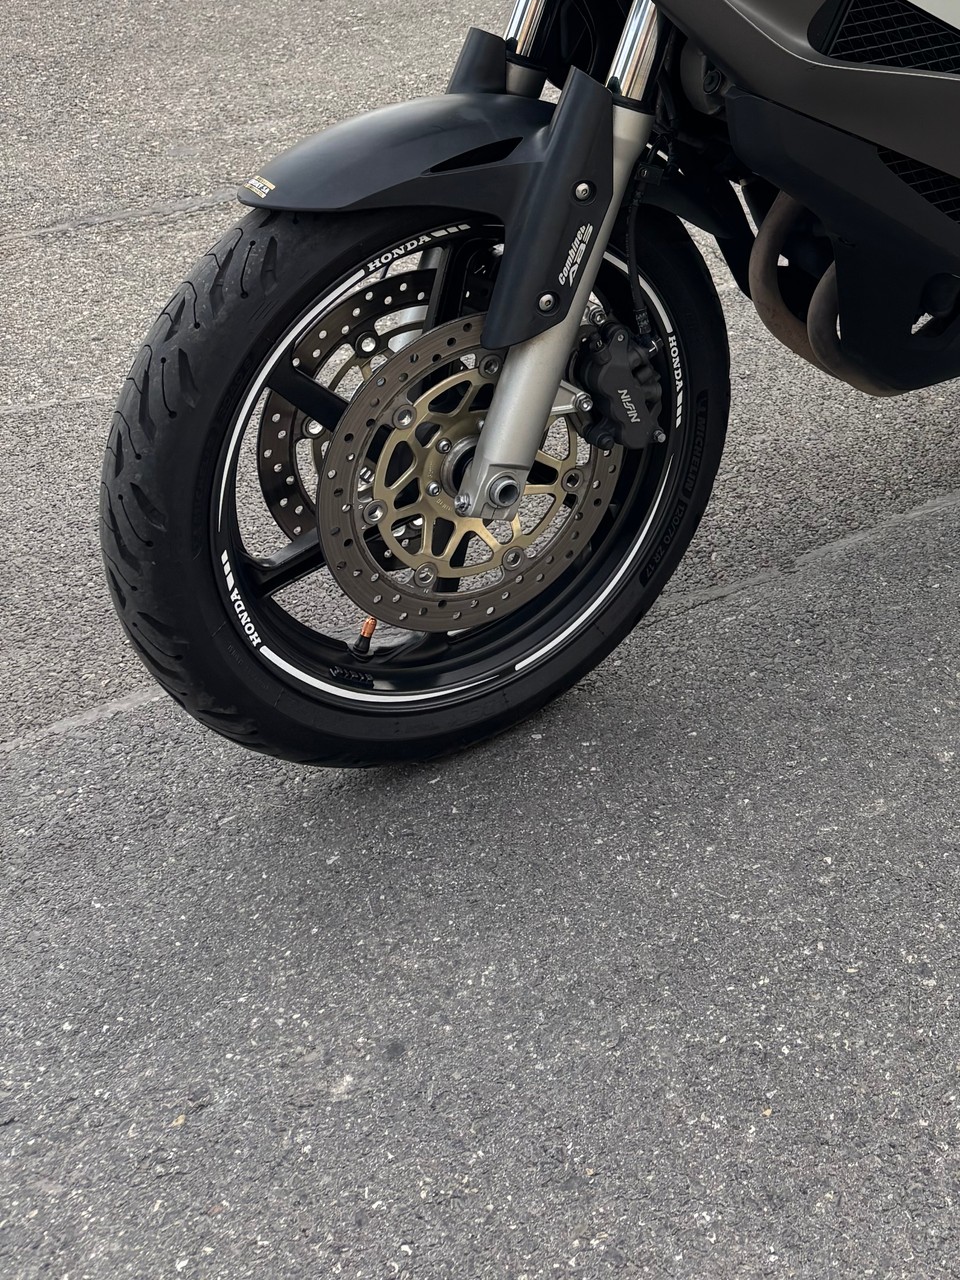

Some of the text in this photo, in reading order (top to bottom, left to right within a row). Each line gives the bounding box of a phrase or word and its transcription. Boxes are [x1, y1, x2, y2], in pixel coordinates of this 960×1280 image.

[367, 234, 432, 272] HONDA
[569, 223, 593, 288] ABS
[668, 335, 683, 392] HONDA
[618, 389, 641, 423] NISSIN
[685, 421, 707, 492] MICHELIN
[663, 505, 686, 545] 120/70
[654, 547, 666, 562] ZR
[230, 587, 262, 647] HONDA
